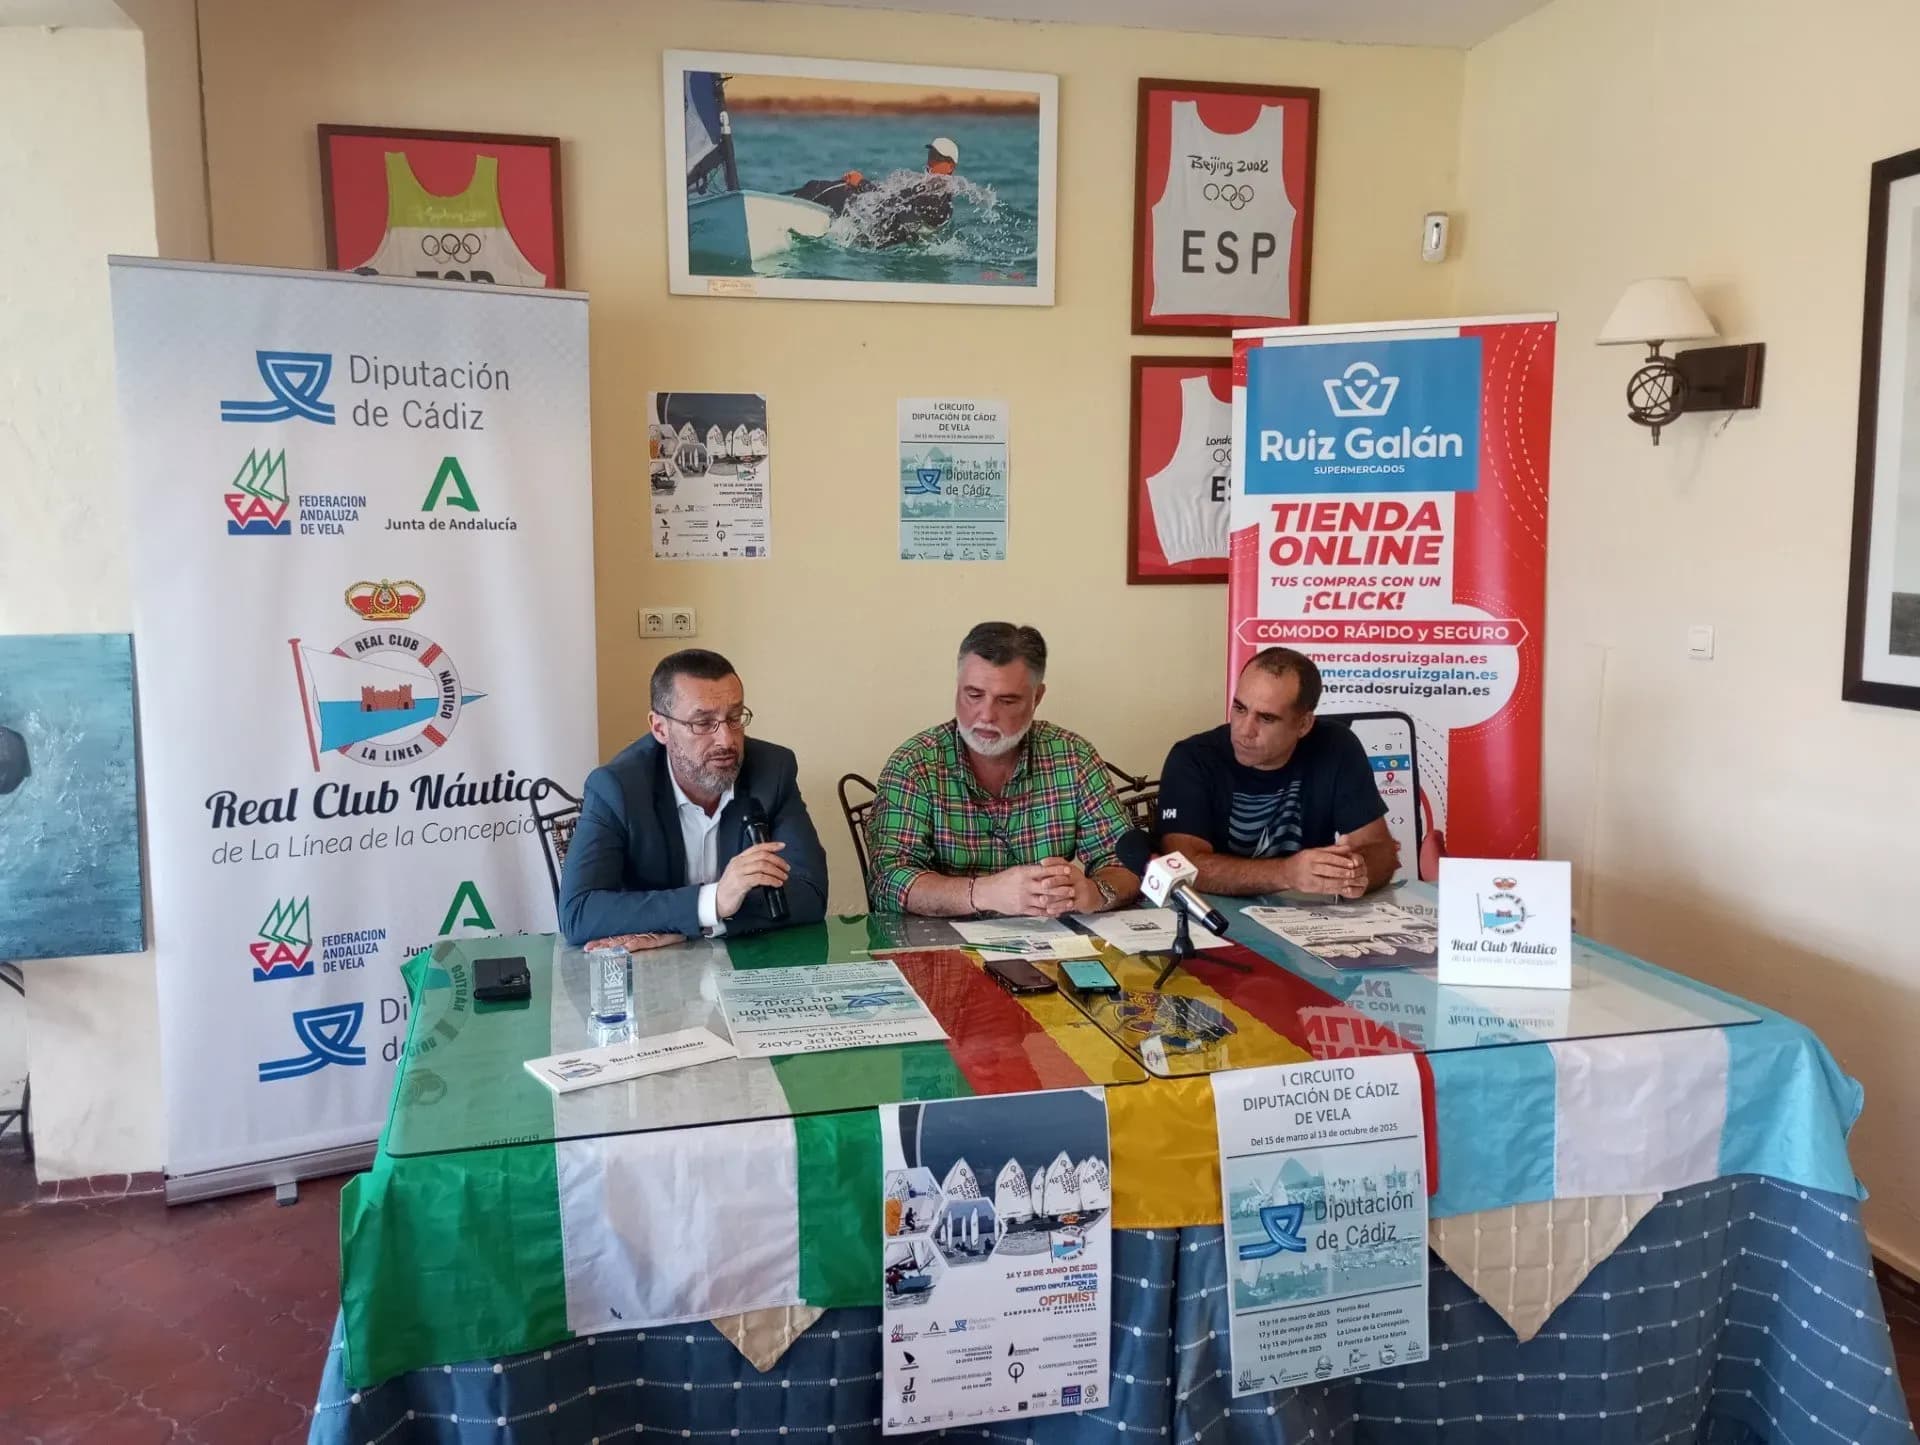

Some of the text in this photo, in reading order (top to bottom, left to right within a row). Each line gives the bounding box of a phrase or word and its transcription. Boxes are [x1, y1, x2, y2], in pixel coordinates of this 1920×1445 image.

[1186, 155, 1269, 177] Beijing 2008
[1182, 229, 1276, 275] ESP
[349, 354, 510, 392] Diputación
[352, 399, 484, 431] de Cádiz
[938, 403, 975, 411] CIRCUITO
[938, 423, 970, 431] DE VELA
[1260, 426, 1463, 462] Ruiz Galán
[945, 470, 1001, 482] Diputación
[1313, 464, 1405, 475] SUPERMERCADOS
[946, 484, 991, 496] de Cádiz
[299, 495, 367, 508] FEDERACION
[300, 509, 359, 522] ANDALUZA
[384, 516, 518, 531] Junta de Andalucía
[1270, 501, 1441, 533] TIENDA
[300, 522, 345, 535] DE VELA
[1269, 535, 1444, 567] ONLINE
[1271, 575, 1441, 588] TUS COMPRAS CON UN
[1303, 590, 1408, 613] ¡CLICK!
[1257, 621, 1510, 642] CÓMODO RÁPIDO y SEGURO
[354, 633, 420, 653] REAL CLUB
[1306, 652, 1487, 666] rmercadosruizgalan.es
[1319, 667, 1499, 681] mercadosruizgalan.es
[438, 669, 456, 720] NÁUTICO
[361, 746, 377, 761] LA
[205, 770, 551, 829] Real Club Náutico
[212, 815, 538, 865] de La Línea de la Concepció
[322, 928, 387, 948] FEDERACION
[1450, 939, 1558, 955] Real Club Náutico
[323, 943, 379, 961] ANDALUZA
[323, 957, 365, 973] DE VELA
[739, 1003, 839, 1017] Diputación
[1282, 1067, 1355, 1087] I CIRCUITO
[1243, 1082, 1400, 1111] DIPUTACIÓN DE CÁDIZ
[1295, 1108, 1351, 1125] DE VELA
[1251, 1123, 1398, 1146] Del 15 de marzo al 13 de octubre de 2025
[1314, 1191, 1414, 1222] Diputación
[1316, 1223, 1397, 1250] de Cádiz
[1045, 1266, 1068, 1275] JUNIO
[1039, 1291, 1097, 1306] OPTIMIST
